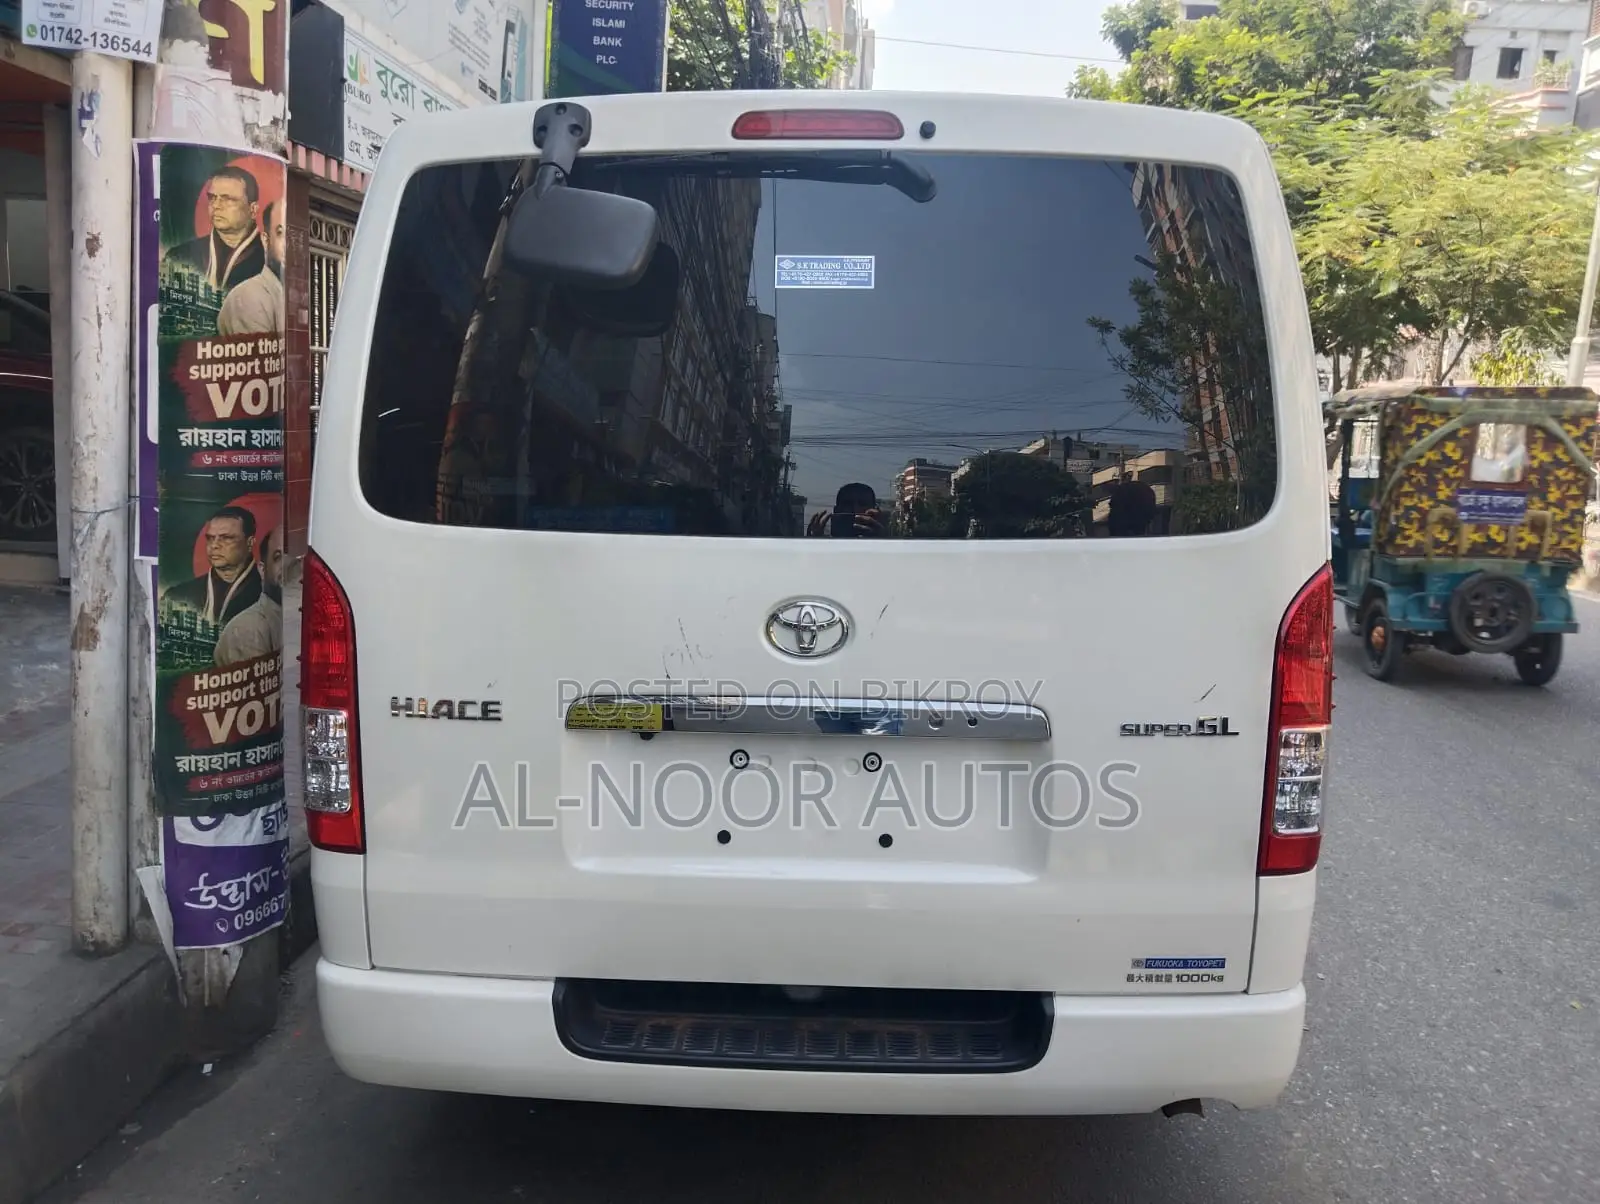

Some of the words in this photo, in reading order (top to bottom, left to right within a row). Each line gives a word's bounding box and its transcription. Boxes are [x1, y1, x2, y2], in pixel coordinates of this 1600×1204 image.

[584, 0, 635, 10] SECURITY
[592, 17, 626, 29] ISLAMI
[40, 24, 153, 58] 01742-136544
[592, 35, 622, 48] BANK
[596, 54, 618, 65] PLC
[196, 341, 254, 360] Honor
[258, 338, 278, 355] the
[189, 358, 260, 381] support
[264, 356, 280, 374] the
[177, 427, 248, 448] রায়হান
[194, 665, 250, 691] Honor
[253, 658, 275, 678] the
[186, 682, 256, 711] support
[259, 676, 278, 694] the
[202, 691, 283, 745] VOT
[1119, 722, 1192, 737] SUPER
[1195, 715, 1240, 736] GL
[175, 750, 242, 773] রায়হান
[1146, 959, 1184, 969] FUKUOKA
[1187, 959, 1224, 969] TOYOPET
[1175, 973, 1225, 983] 1000kg
